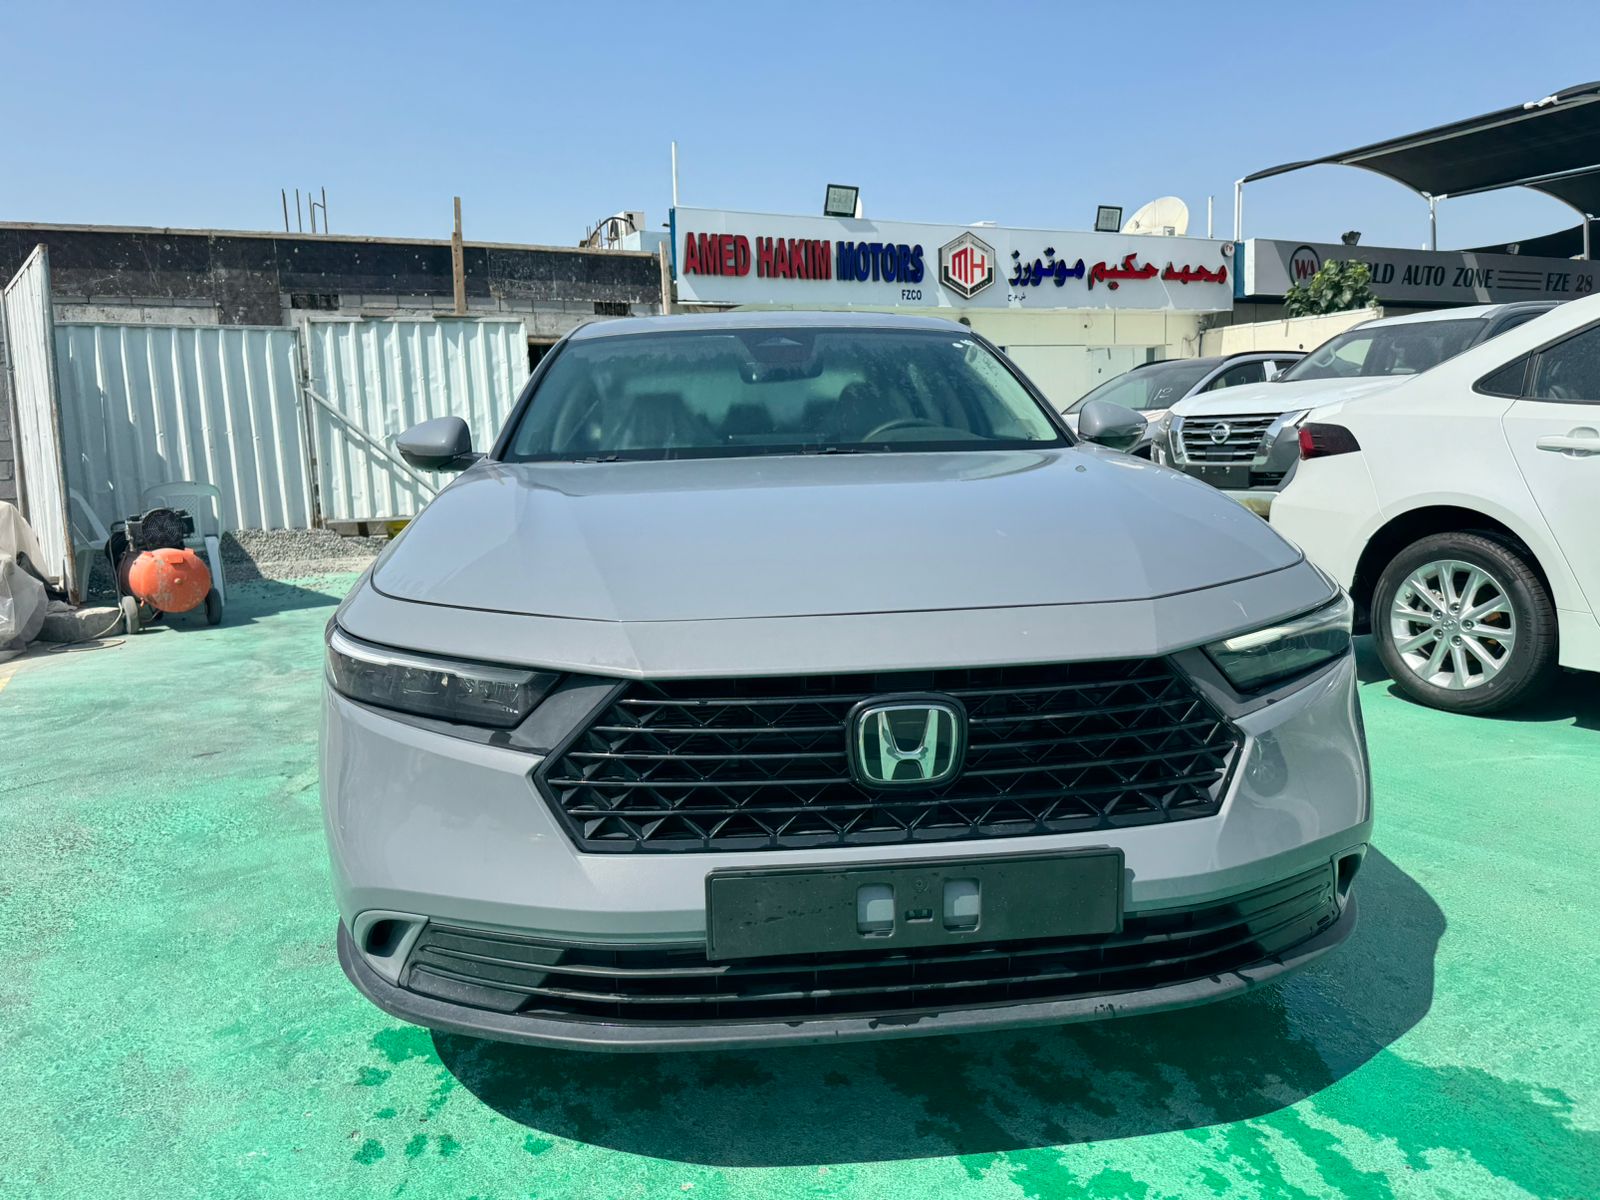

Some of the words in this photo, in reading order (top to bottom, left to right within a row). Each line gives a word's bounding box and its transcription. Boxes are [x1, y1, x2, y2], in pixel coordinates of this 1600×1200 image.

[683, 232, 751, 277] AMED
[756, 236, 832, 280] HAKIM
[836, 241, 924, 284] MOTORS
[1008, 247, 1085, 287] موتورز
[1087, 252, 1159, 291] حكيم
[1161, 261, 1227, 285] محمد
[901, 289, 922, 301] FZCO
[1401, 264, 1446, 287] AUTO
[1452, 267, 1495, 289] ZONE
[1545, 272, 1571, 292] FZE
[1575, 274, 1593, 293] 28
